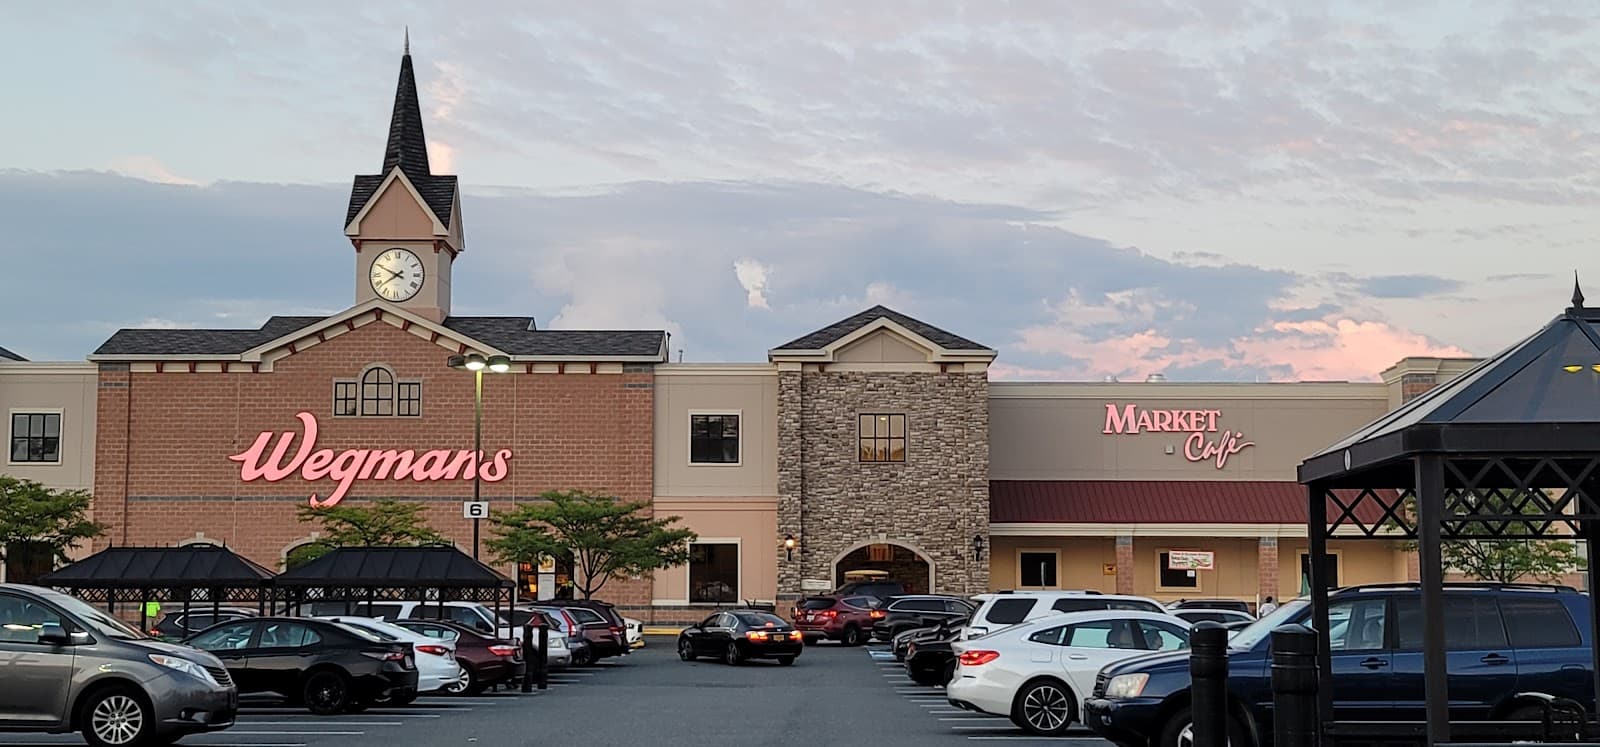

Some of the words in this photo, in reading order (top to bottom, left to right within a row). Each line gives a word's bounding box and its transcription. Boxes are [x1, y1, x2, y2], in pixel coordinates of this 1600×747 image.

[1103, 404, 1222, 434] MARKET
[229, 411, 513, 508] Wegmans
[1184, 431, 1256, 469] Café
[470, 503, 482, 516] 6
